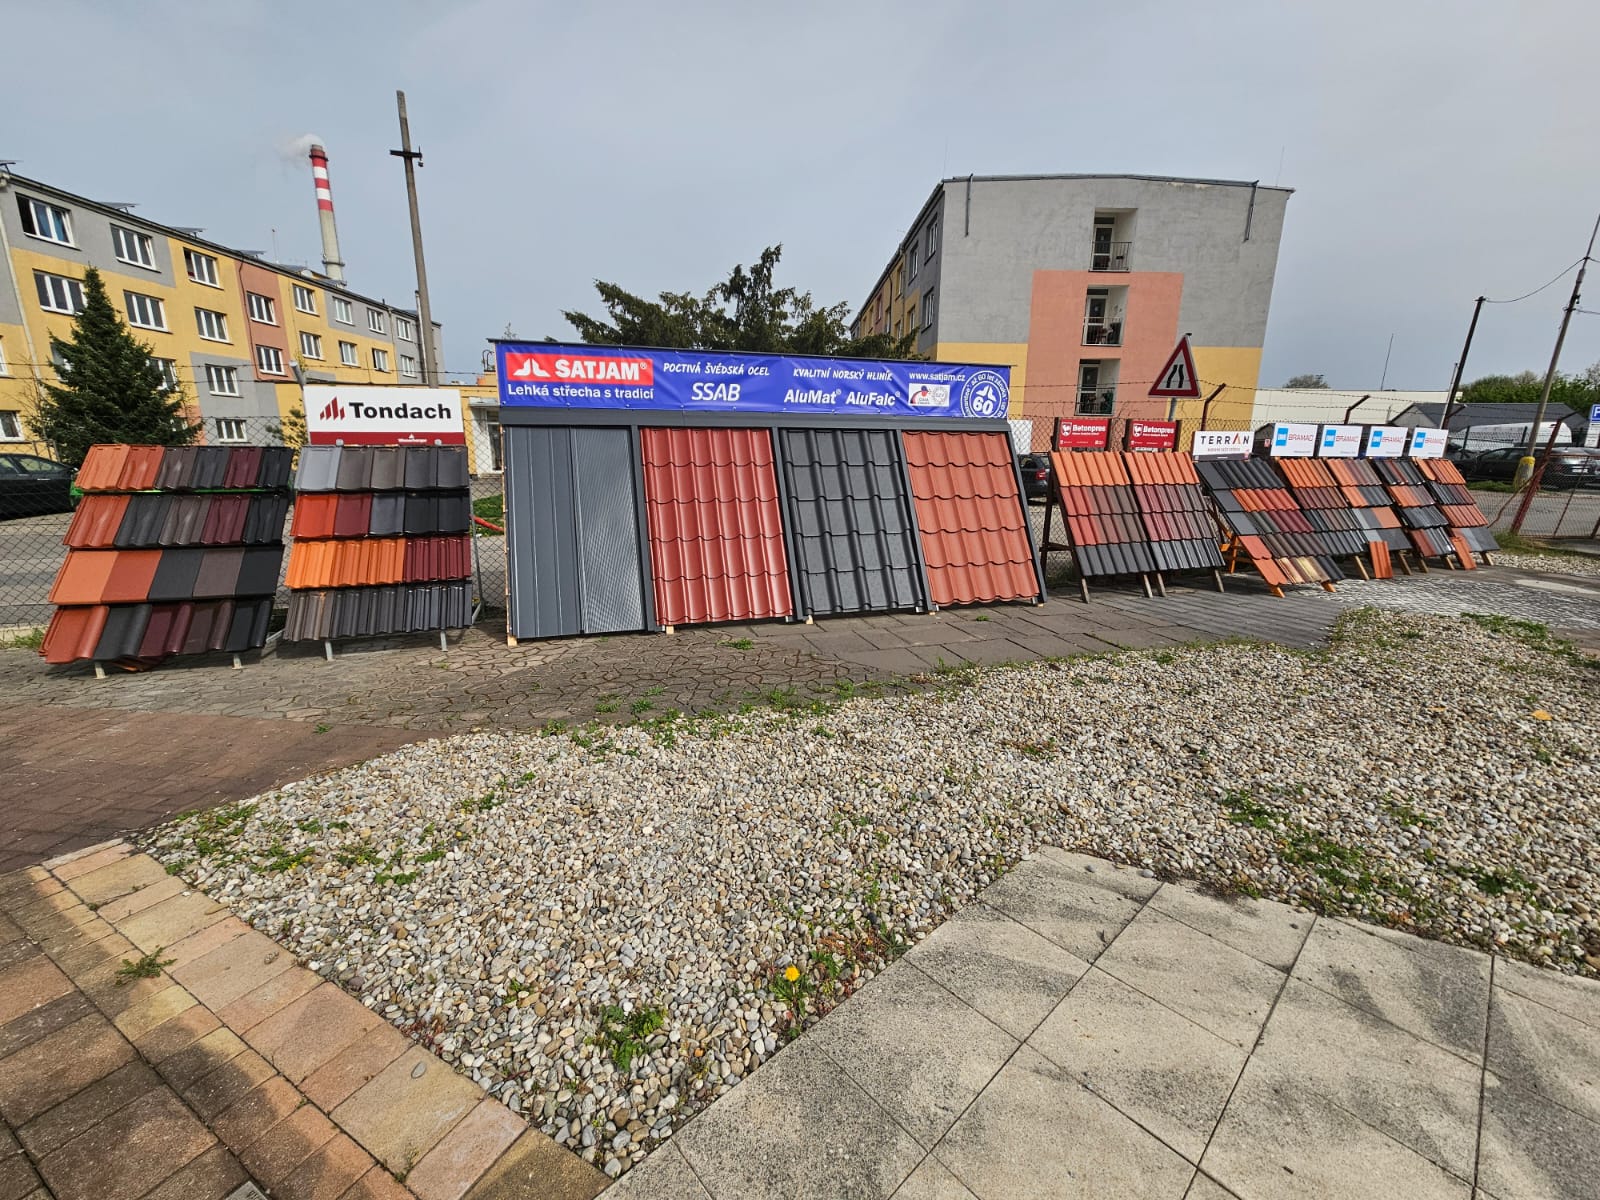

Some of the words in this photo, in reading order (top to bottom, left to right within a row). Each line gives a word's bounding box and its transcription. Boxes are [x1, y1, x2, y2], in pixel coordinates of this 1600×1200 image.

[663, 361, 701, 374] POCTIVÁ
[704, 362, 744, 375] ŠVÉDSKÁ
[747, 366, 770, 376] OCEL
[793, 367, 831, 379] KVALITNÍ
[832, 368, 865, 380] NORSKÝ
[866, 369, 893, 382] HLINÍK
[909, 372, 966, 383] www.satjam.cz
[507, 384, 549, 396] Lehká
[552, 385, 600, 398] střecha
[603, 388, 611, 398] s
[615, 388, 654, 400] tradicí
[691, 382, 741, 402] SSAB
[348, 402, 451, 419] Tondach
[972, 395, 994, 415] 60
[1200, 433, 1250, 445] TERRAN
